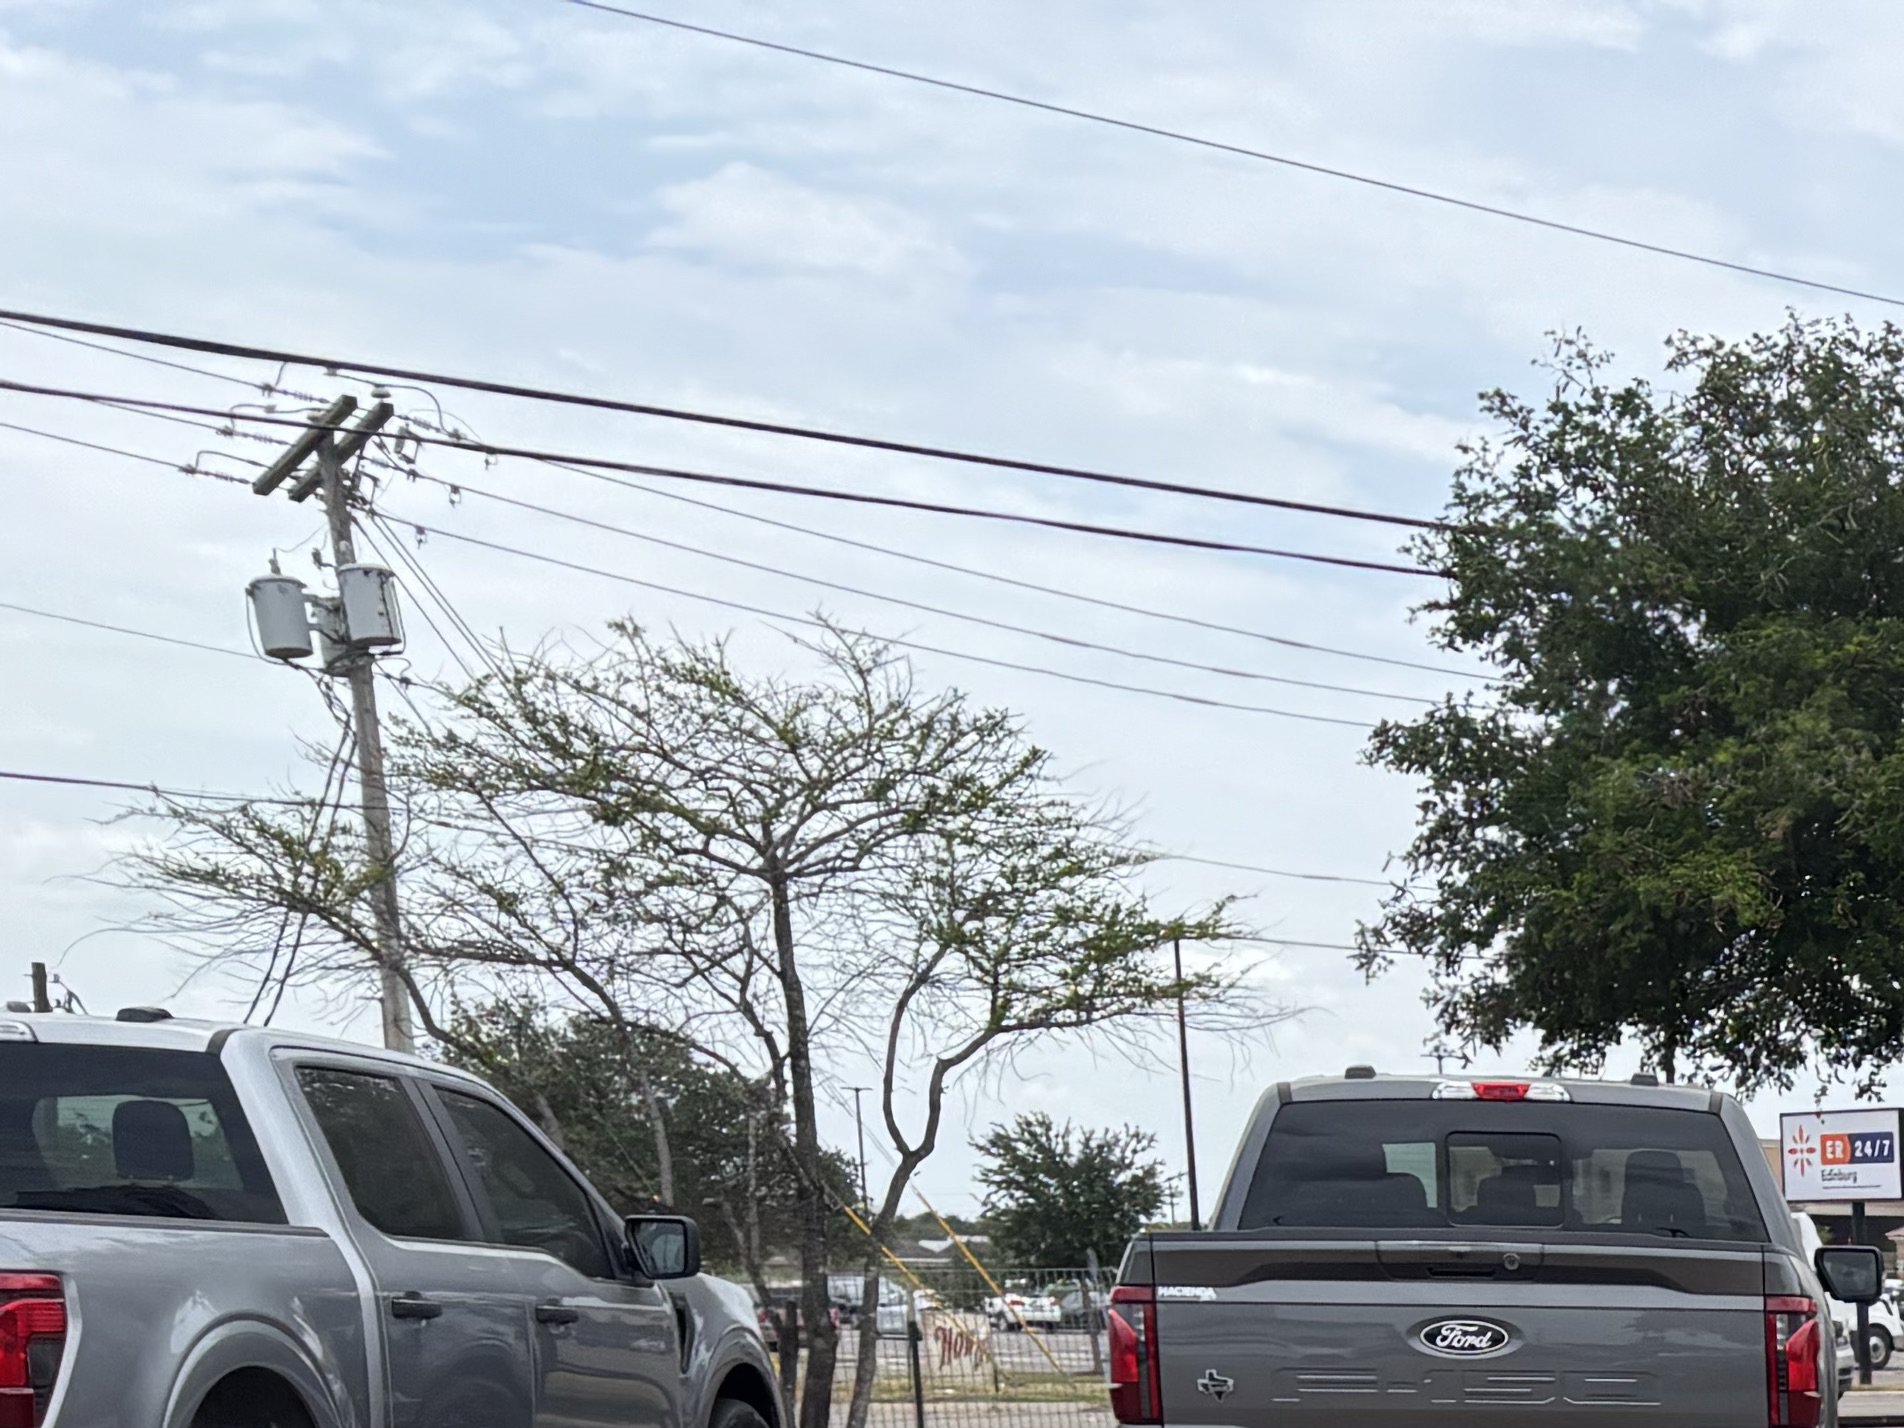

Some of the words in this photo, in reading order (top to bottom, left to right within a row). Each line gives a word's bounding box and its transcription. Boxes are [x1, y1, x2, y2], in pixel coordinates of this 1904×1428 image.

[1825, 1140, 1844, 1159] ER
[1854, 1139, 1890, 1157] 24/7
[1436, 1324, 1492, 1348] Ford
